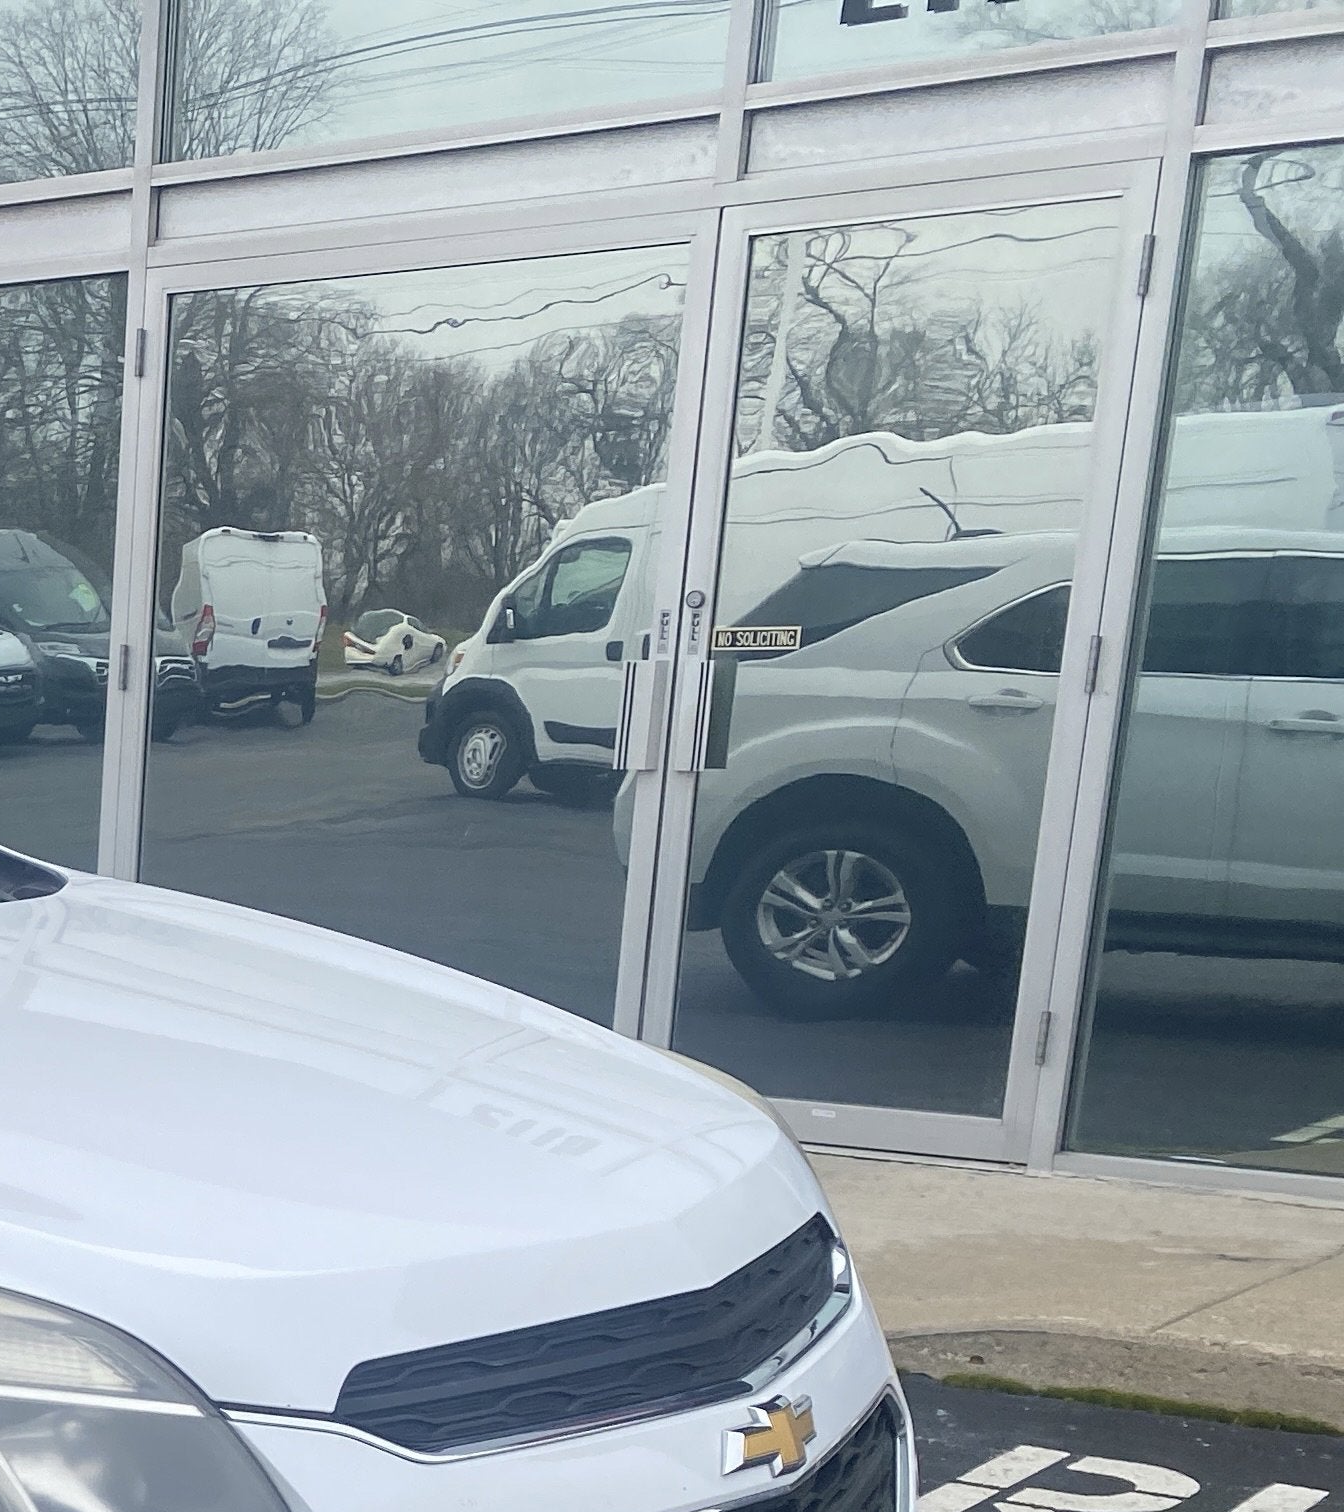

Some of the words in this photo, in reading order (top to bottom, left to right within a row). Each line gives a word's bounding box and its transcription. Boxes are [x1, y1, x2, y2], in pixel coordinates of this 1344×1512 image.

[660, 612, 670, 640] PULL
[691, 613, 700, 641] PULL
[717, 631, 732, 647] NO
[735, 630, 796, 647] SOLICITING
